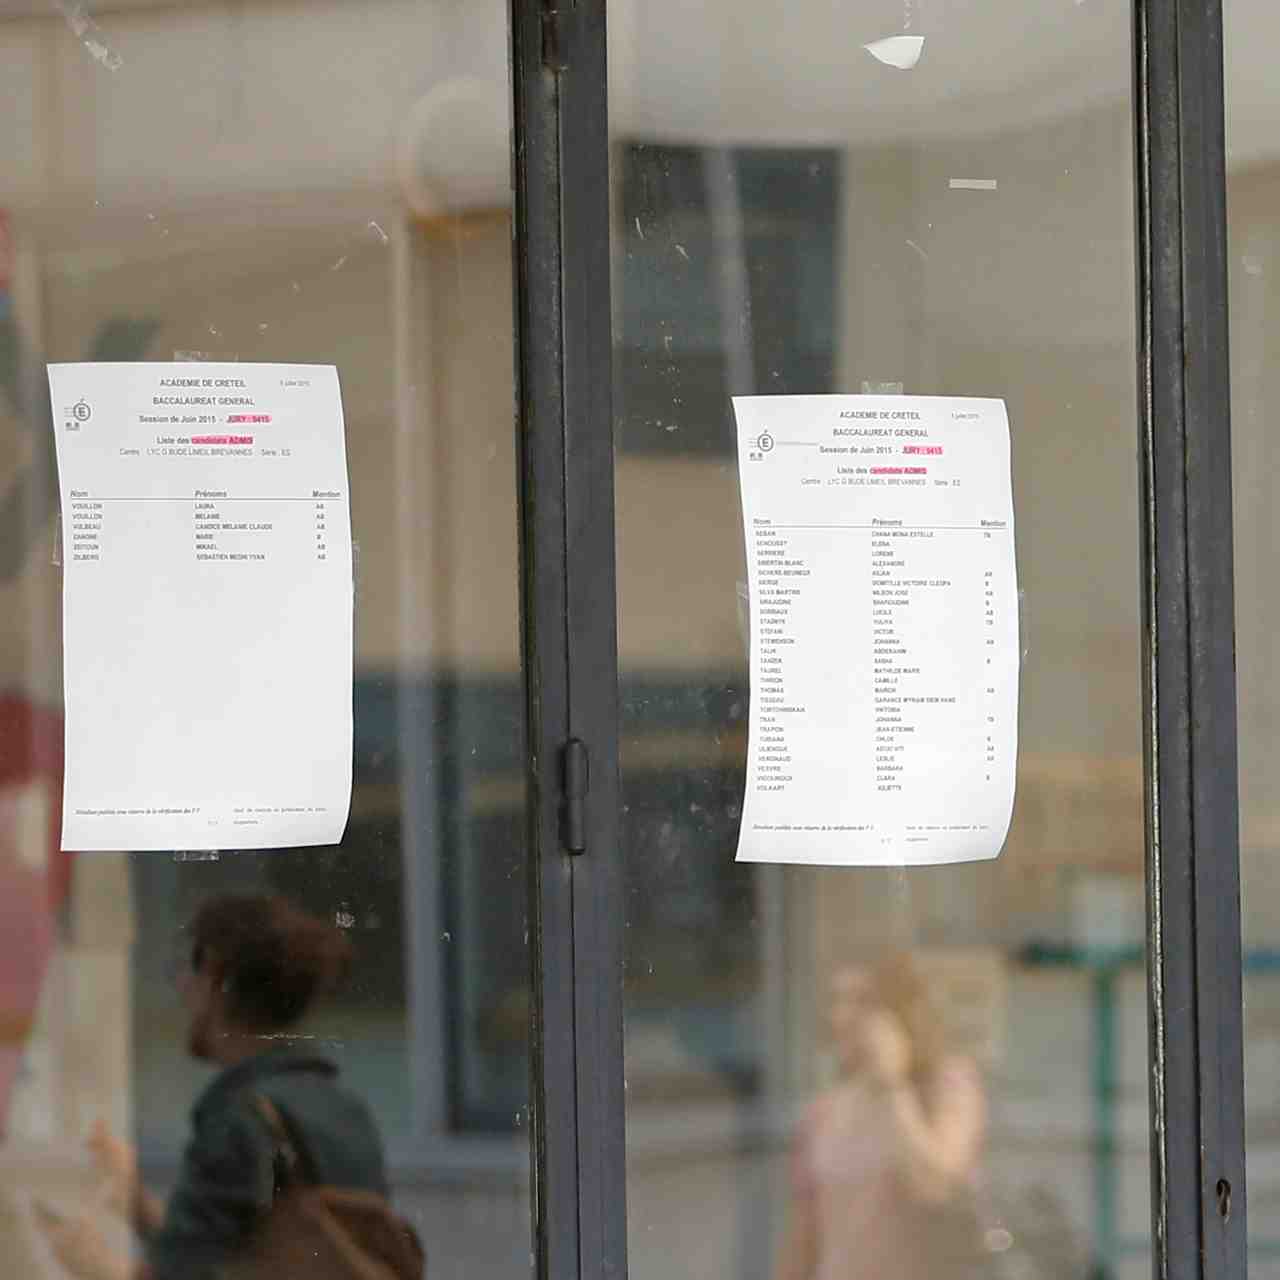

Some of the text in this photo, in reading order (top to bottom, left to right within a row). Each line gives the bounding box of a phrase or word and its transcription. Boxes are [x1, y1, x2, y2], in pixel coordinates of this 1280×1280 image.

[160, 379, 200, 387] ACADEMIE
[153, 397, 216, 405] BACCALAUREAT
[139, 415, 169, 423] Session
[891, 412, 920, 420] CRETEIL
[894, 429, 928, 437] GENERAL
[311, 490, 340, 498] Mention
